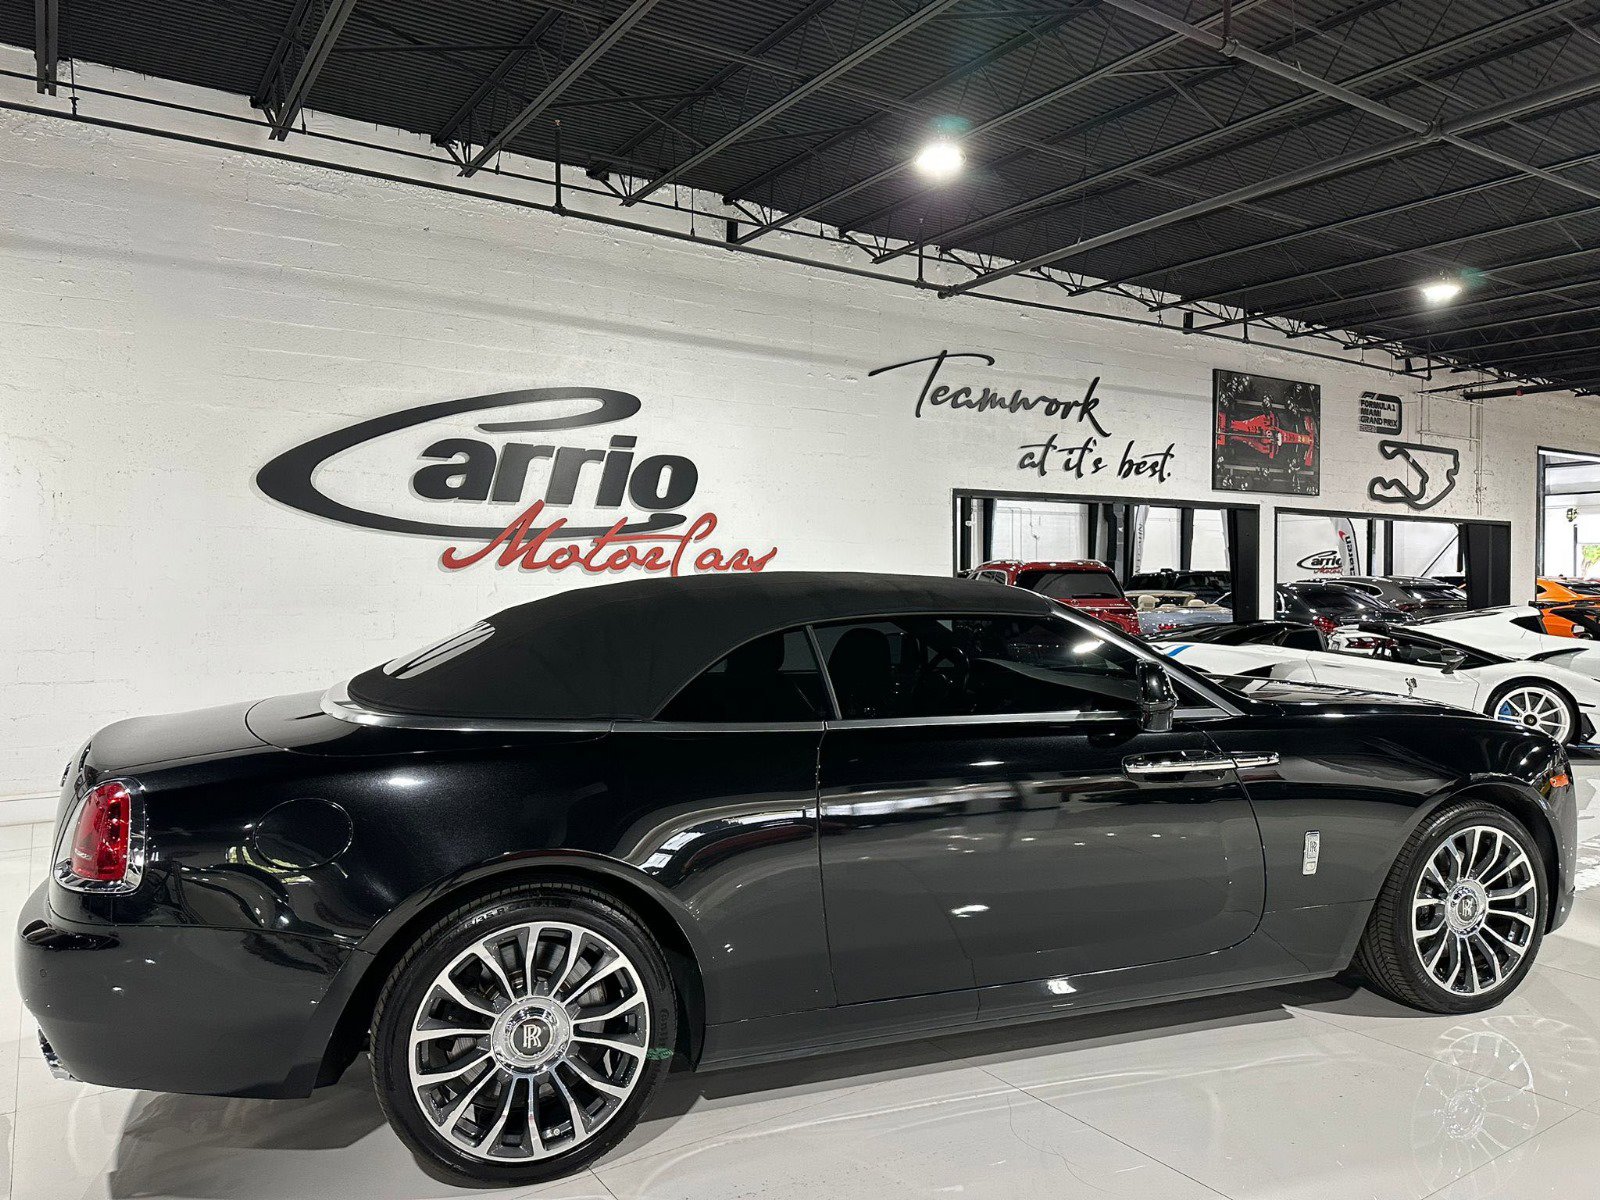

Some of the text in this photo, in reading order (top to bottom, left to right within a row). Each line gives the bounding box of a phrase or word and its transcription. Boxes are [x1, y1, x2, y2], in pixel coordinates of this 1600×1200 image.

[868, 350, 1112, 437] Teamwork
[256, 386, 699, 542] Carrio
[1020, 434, 1058, 477] at
[1056, 436, 1108, 479] it's
